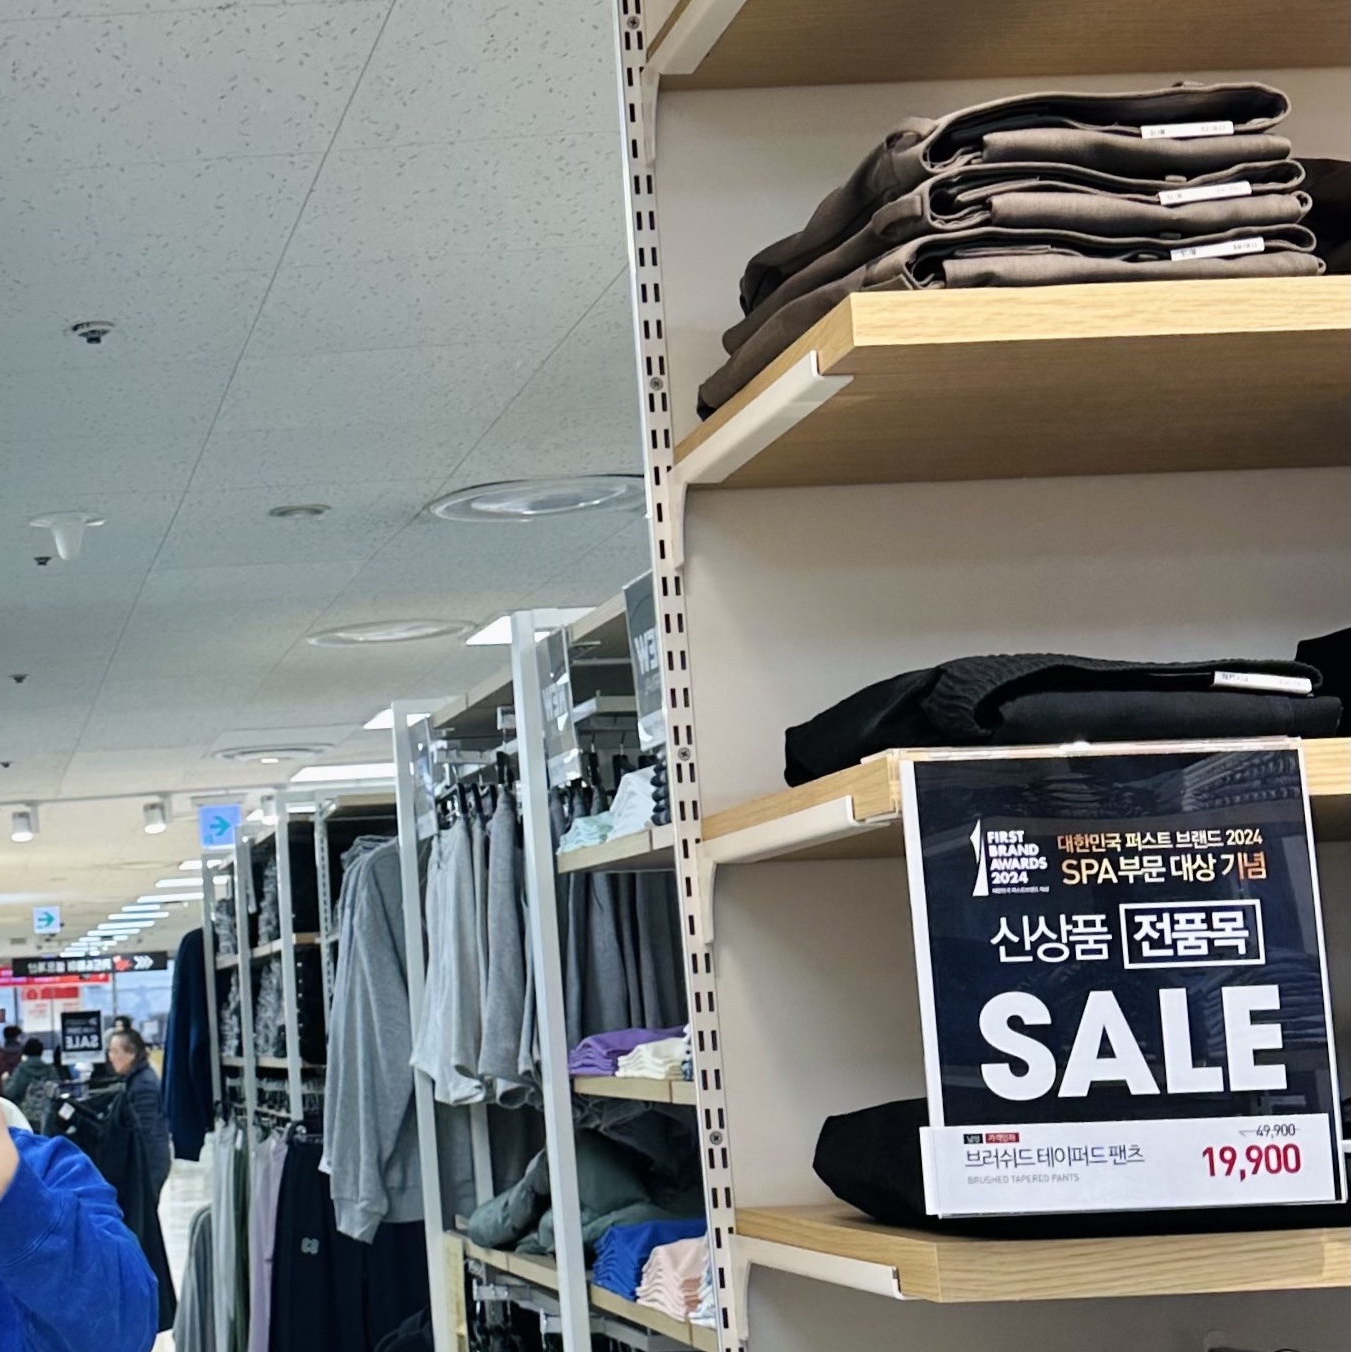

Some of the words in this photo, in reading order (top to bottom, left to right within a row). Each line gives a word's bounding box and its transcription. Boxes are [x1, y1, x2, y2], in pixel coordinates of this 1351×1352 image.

[987, 830, 1025, 844] FIRST
[1057, 832, 1122, 853] 대한민국
[1125, 831, 1174, 850] 퍼스트
[1176, 829, 1225, 849] 브랜드
[1226, 828, 1263, 846] 2024
[988, 843, 1040, 858] BRAND
[990, 857, 1048, 871] AWARDS
[1170, 853, 1217, 882] 대상
[1221, 851, 1267, 881] 기념
[991, 871, 1029, 885] 2024
[990, 913, 1113, 963] 신상품
[1133, 910, 1249, 957] 전품목
[979, 984, 1288, 1101] SALE
[1256, 1123, 1296, 1139] 49,900
[1201, 1143, 1301, 1182] 19,900
[967, 1175, 1009, 1185] BRUSHED
[1011, 1174, 1050, 1184] TAPERED
[1051, 1173, 1080, 1183] PANTS
